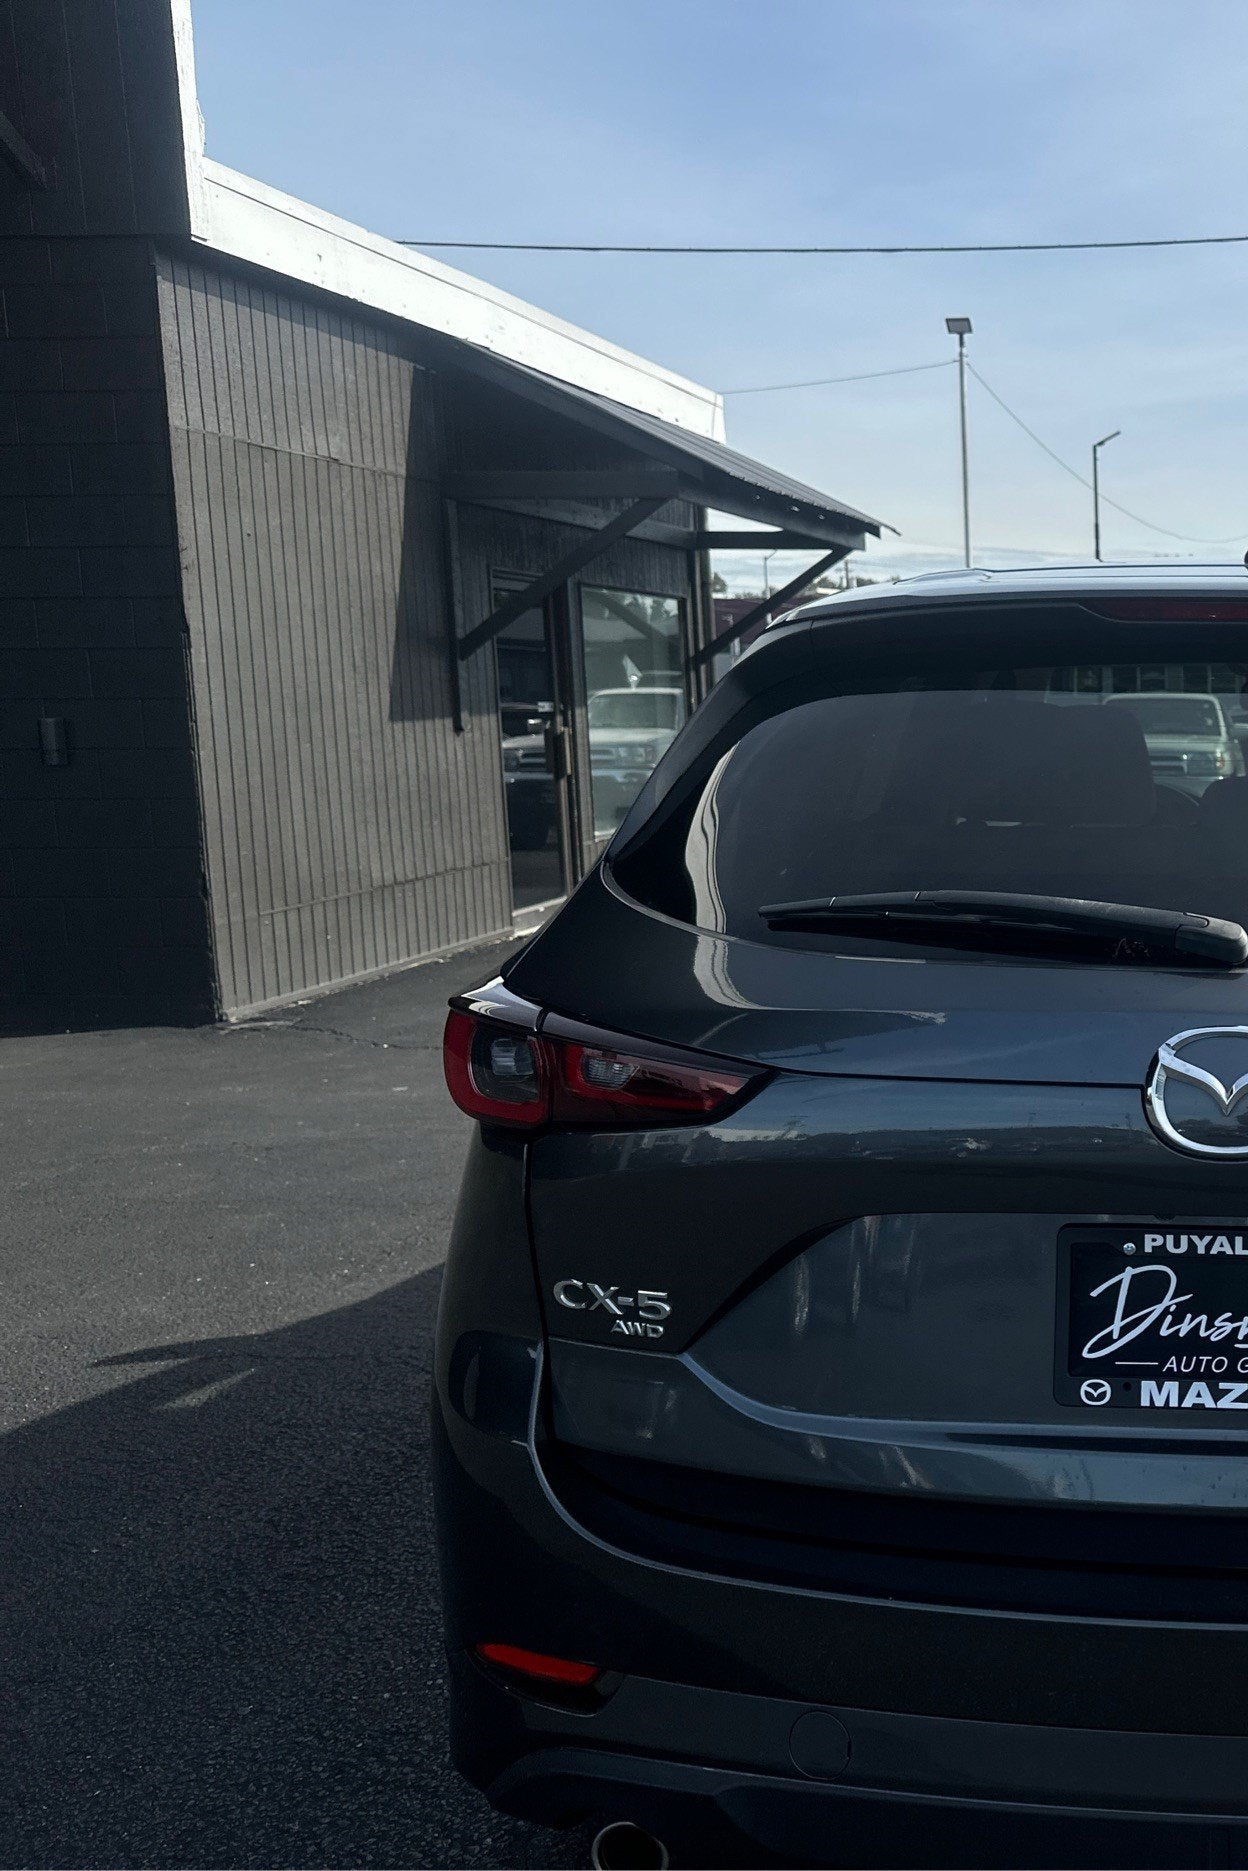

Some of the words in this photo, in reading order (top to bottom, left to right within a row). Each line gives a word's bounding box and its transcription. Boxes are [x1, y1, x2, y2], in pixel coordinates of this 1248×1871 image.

[553, 1279, 672, 1320] CX-5
[611, 1319, 665, 1339] AWD
[1163, 1356, 1228, 1373] AUTO
